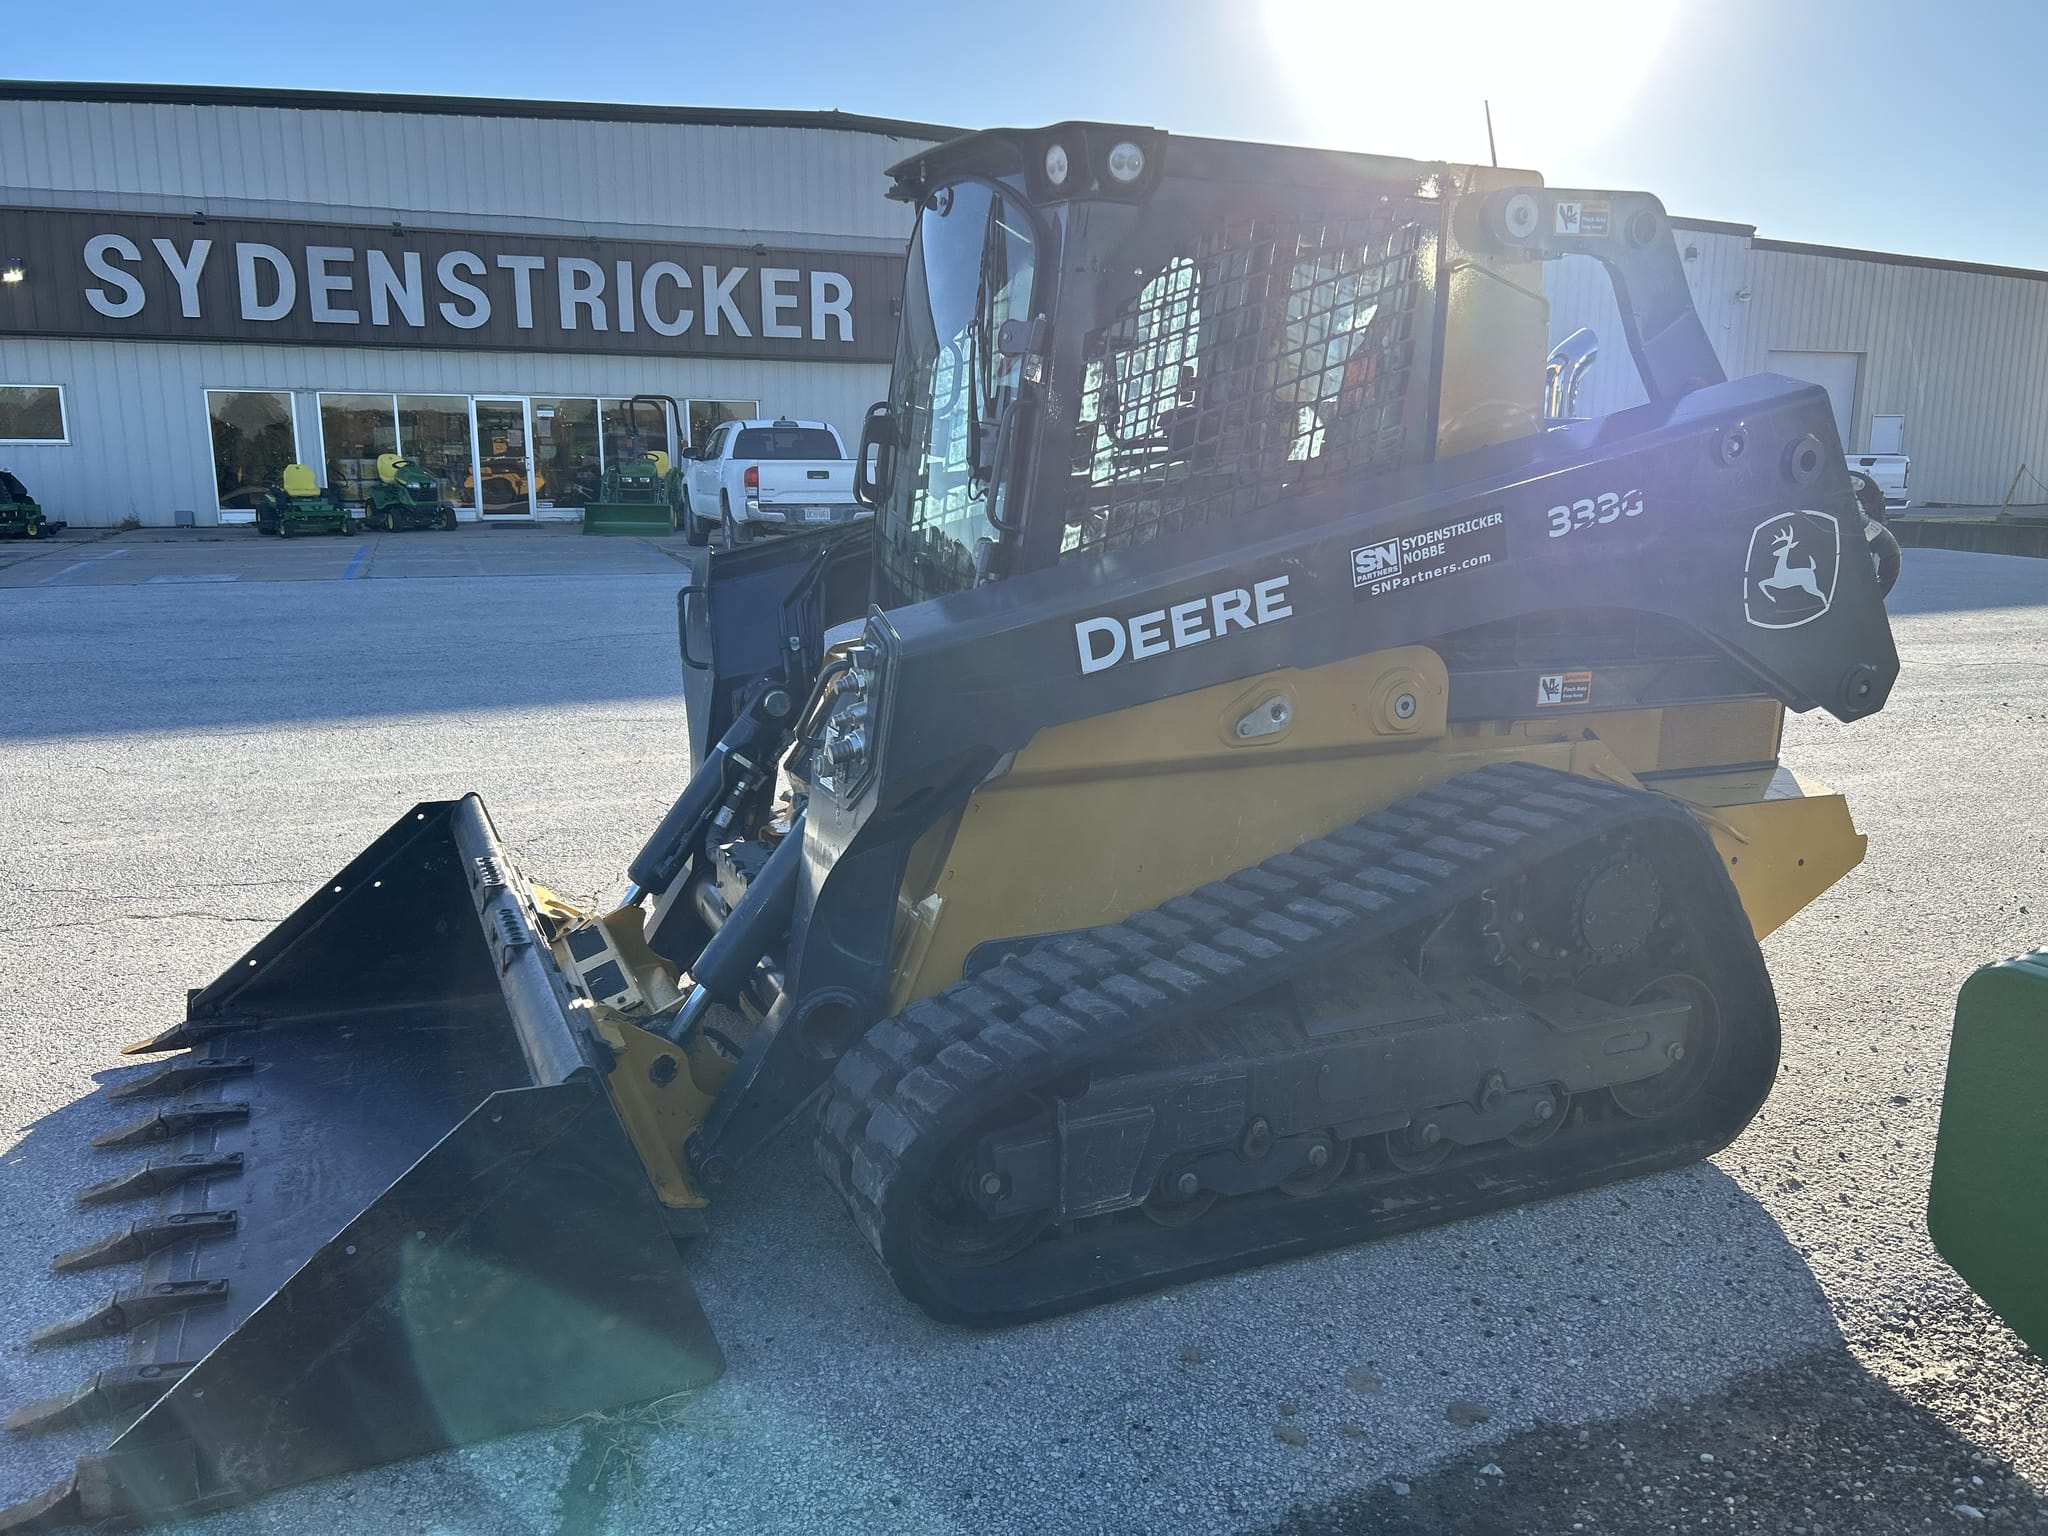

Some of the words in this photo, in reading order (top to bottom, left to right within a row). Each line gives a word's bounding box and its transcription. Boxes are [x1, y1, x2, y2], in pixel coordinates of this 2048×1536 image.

[83, 233, 854, 342] SYDENSTRICKER
[1401, 512, 1503, 551] SYDENSTRICKER
[1357, 565, 1398, 583] PARTNERS
[1371, 552, 1491, 596] SNPartners.com
[1403, 543, 1446, 565] NOBBE
[1075, 575, 1293, 675] DEERE
